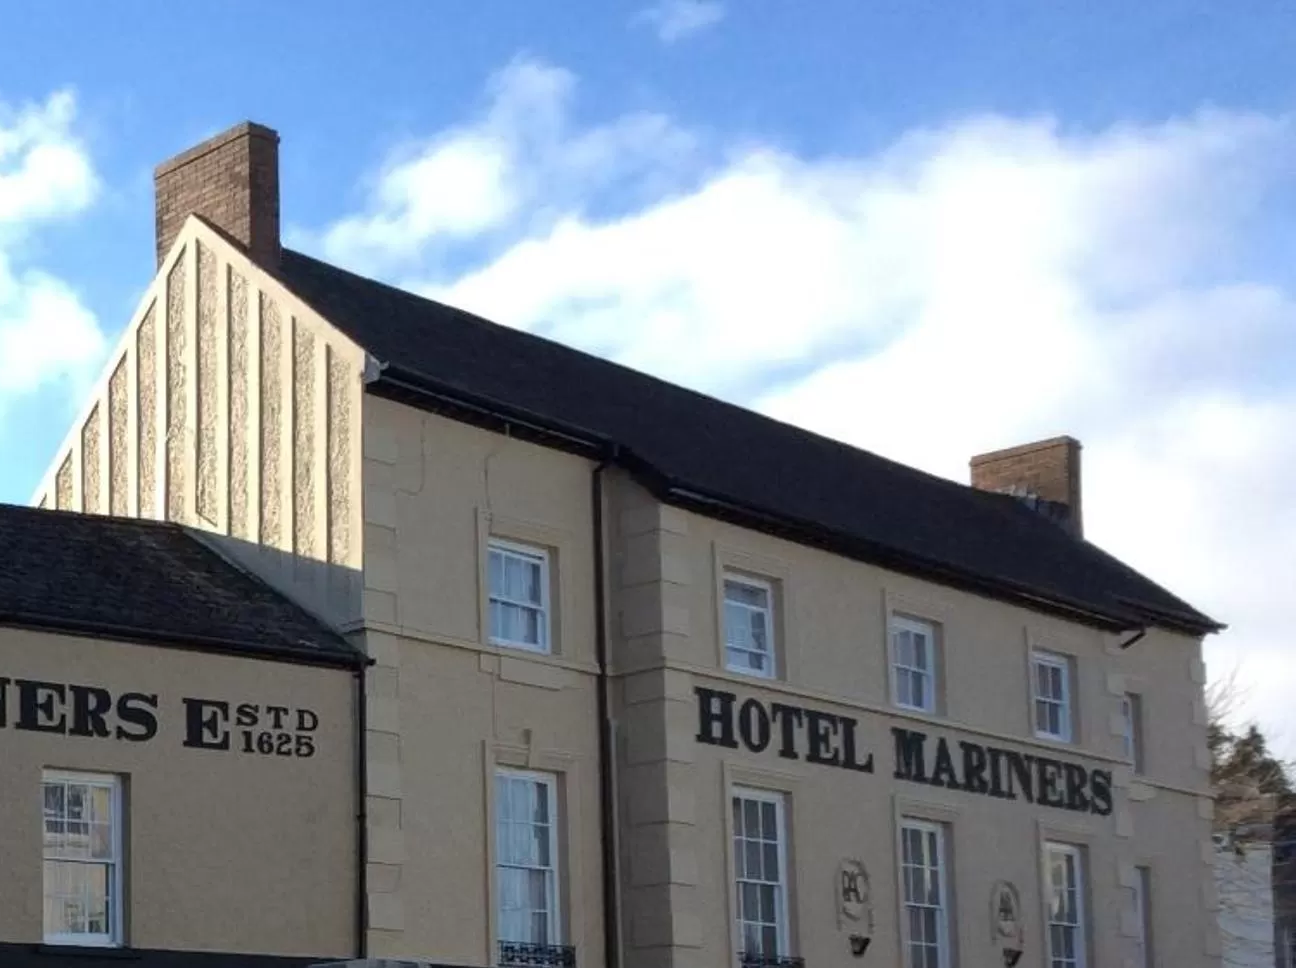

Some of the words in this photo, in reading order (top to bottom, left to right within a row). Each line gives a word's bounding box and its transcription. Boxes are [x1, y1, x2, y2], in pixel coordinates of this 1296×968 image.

[181, 697, 319, 752] ESTD
[241, 730, 315, 758] 1625
[693, 686, 874, 774] HOTEL
[890, 726, 1113, 816] MARINERS
